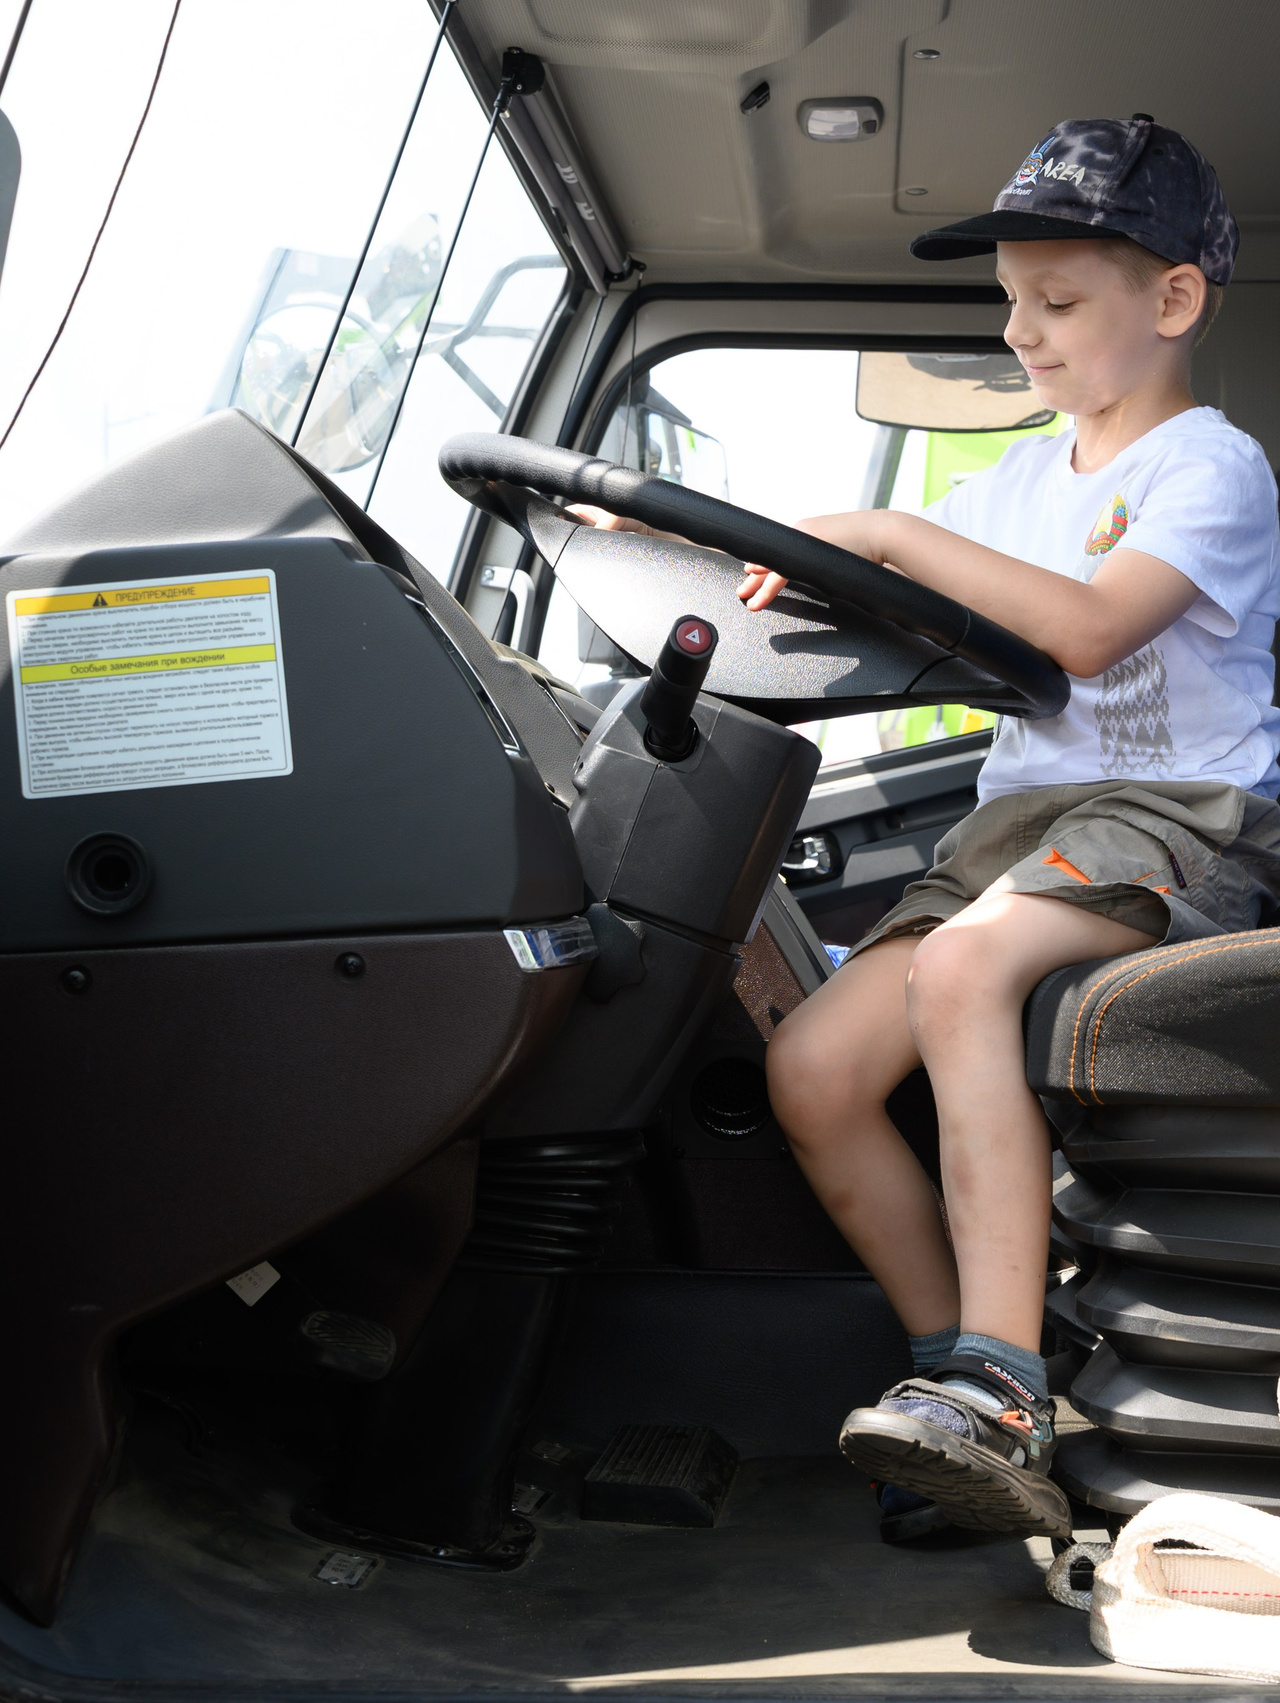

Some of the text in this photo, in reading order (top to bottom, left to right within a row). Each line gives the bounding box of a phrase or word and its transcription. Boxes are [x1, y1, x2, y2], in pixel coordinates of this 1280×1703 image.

[1038, 157, 1086, 187] AREA
[115, 586, 196, 602] ПРЕДУПРЕЖДЕНИЕ
[70, 653, 225, 675] Особые замечания при вождении
